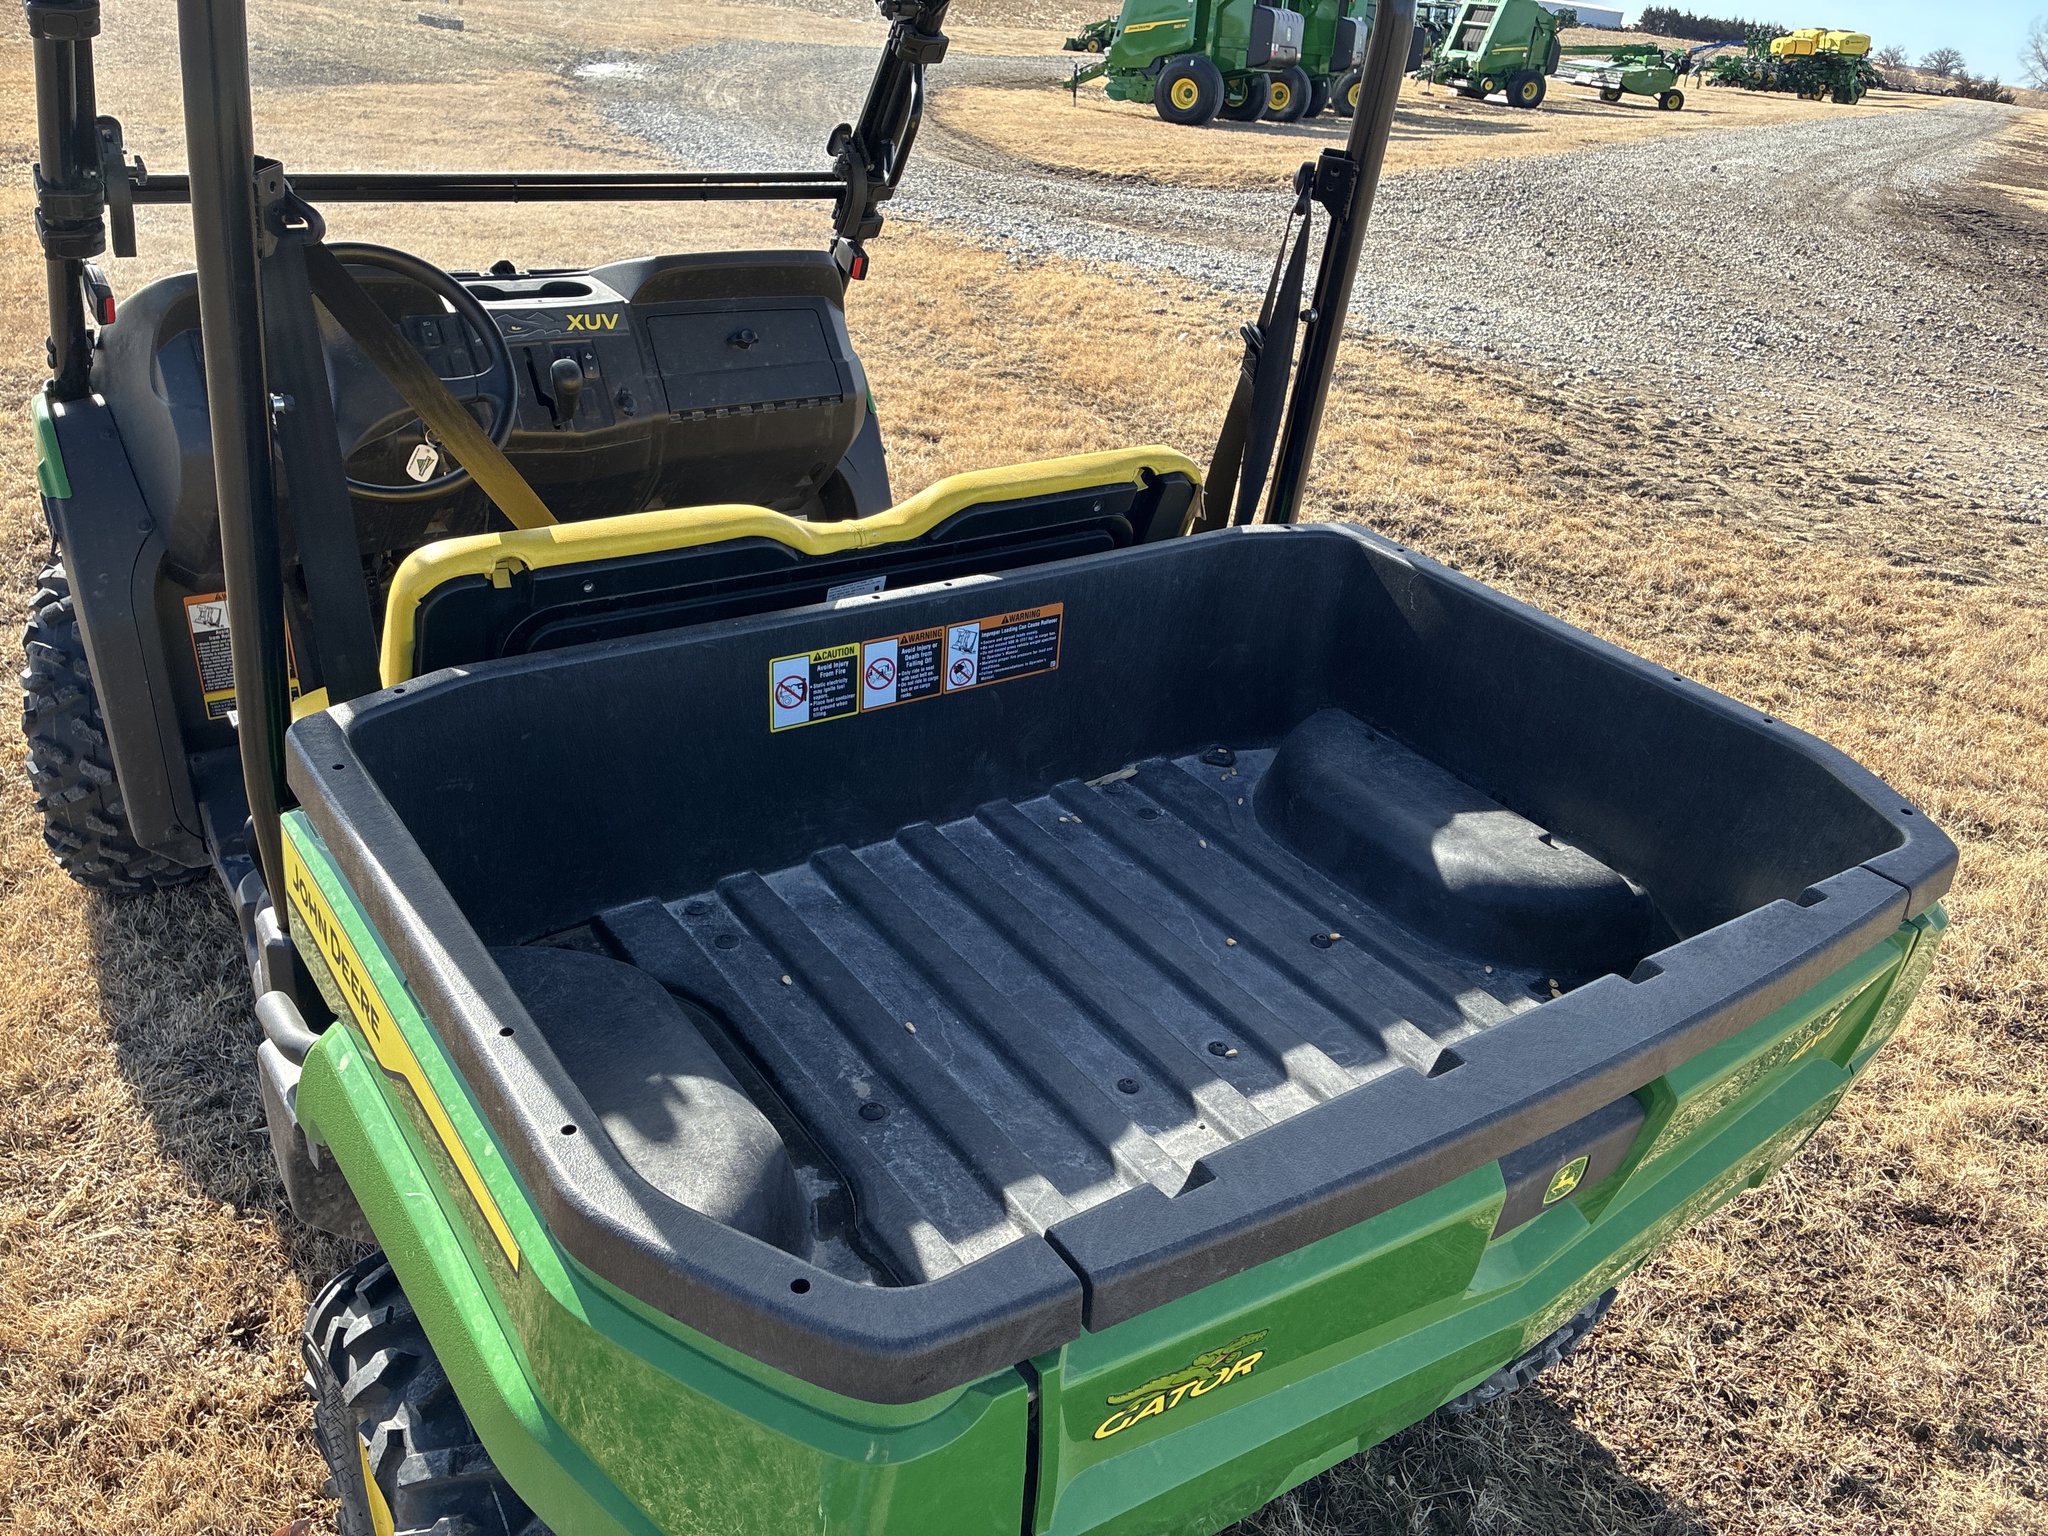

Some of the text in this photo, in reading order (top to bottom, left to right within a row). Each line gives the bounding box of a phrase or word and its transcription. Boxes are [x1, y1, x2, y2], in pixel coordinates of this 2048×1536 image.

[566, 313, 619, 331] XUV
[1009, 609, 1040, 622] WARNING
[982, 629, 1000, 638] Improper
[1001, 626, 1017, 634] Loading
[1041, 618, 1058, 626] Rollover
[909, 629, 942, 642] WARNING
[822, 646, 854, 660] CAUTION
[901, 646, 915, 654] Avoid
[917, 644, 931, 652] Injury
[817, 661, 849, 671] Avoid Injury
[906, 660, 923, 668] Falling
[820, 670, 834, 678] From
[293, 864, 380, 1043] JOHN DEERE
[1093, 1351, 1265, 1439] GATOR
